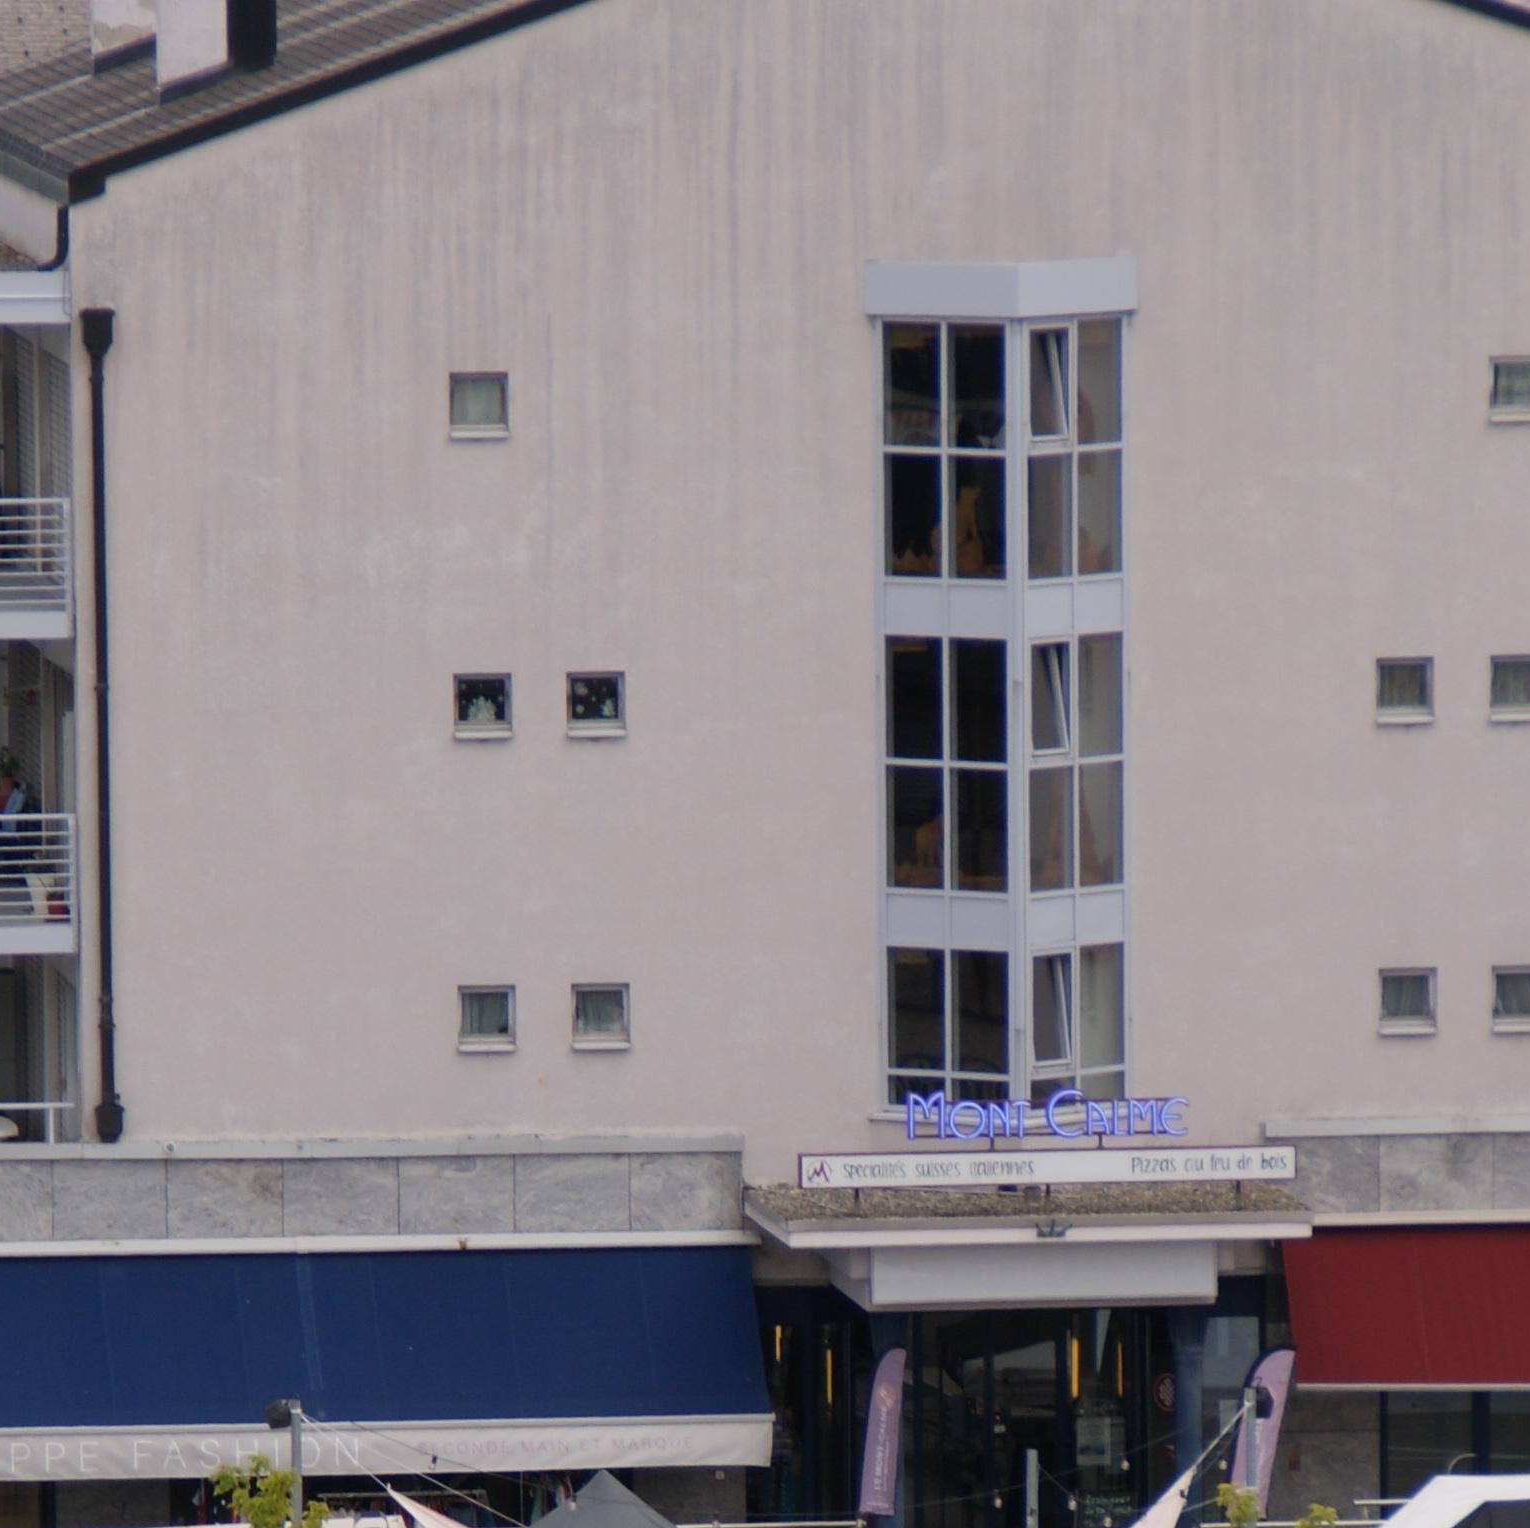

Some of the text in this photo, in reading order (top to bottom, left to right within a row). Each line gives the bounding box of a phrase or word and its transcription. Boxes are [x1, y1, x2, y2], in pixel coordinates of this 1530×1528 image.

[1131, 1156, 1177, 1174] Pizzas
[1184, 1158, 1205, 1172] au
[1260, 1152, 1287, 1170] bois
[132, 1437, 361, 1471] FASHION
[520, 1439, 569, 1455] MAIN
[578, 1437, 601, 1451] ET
